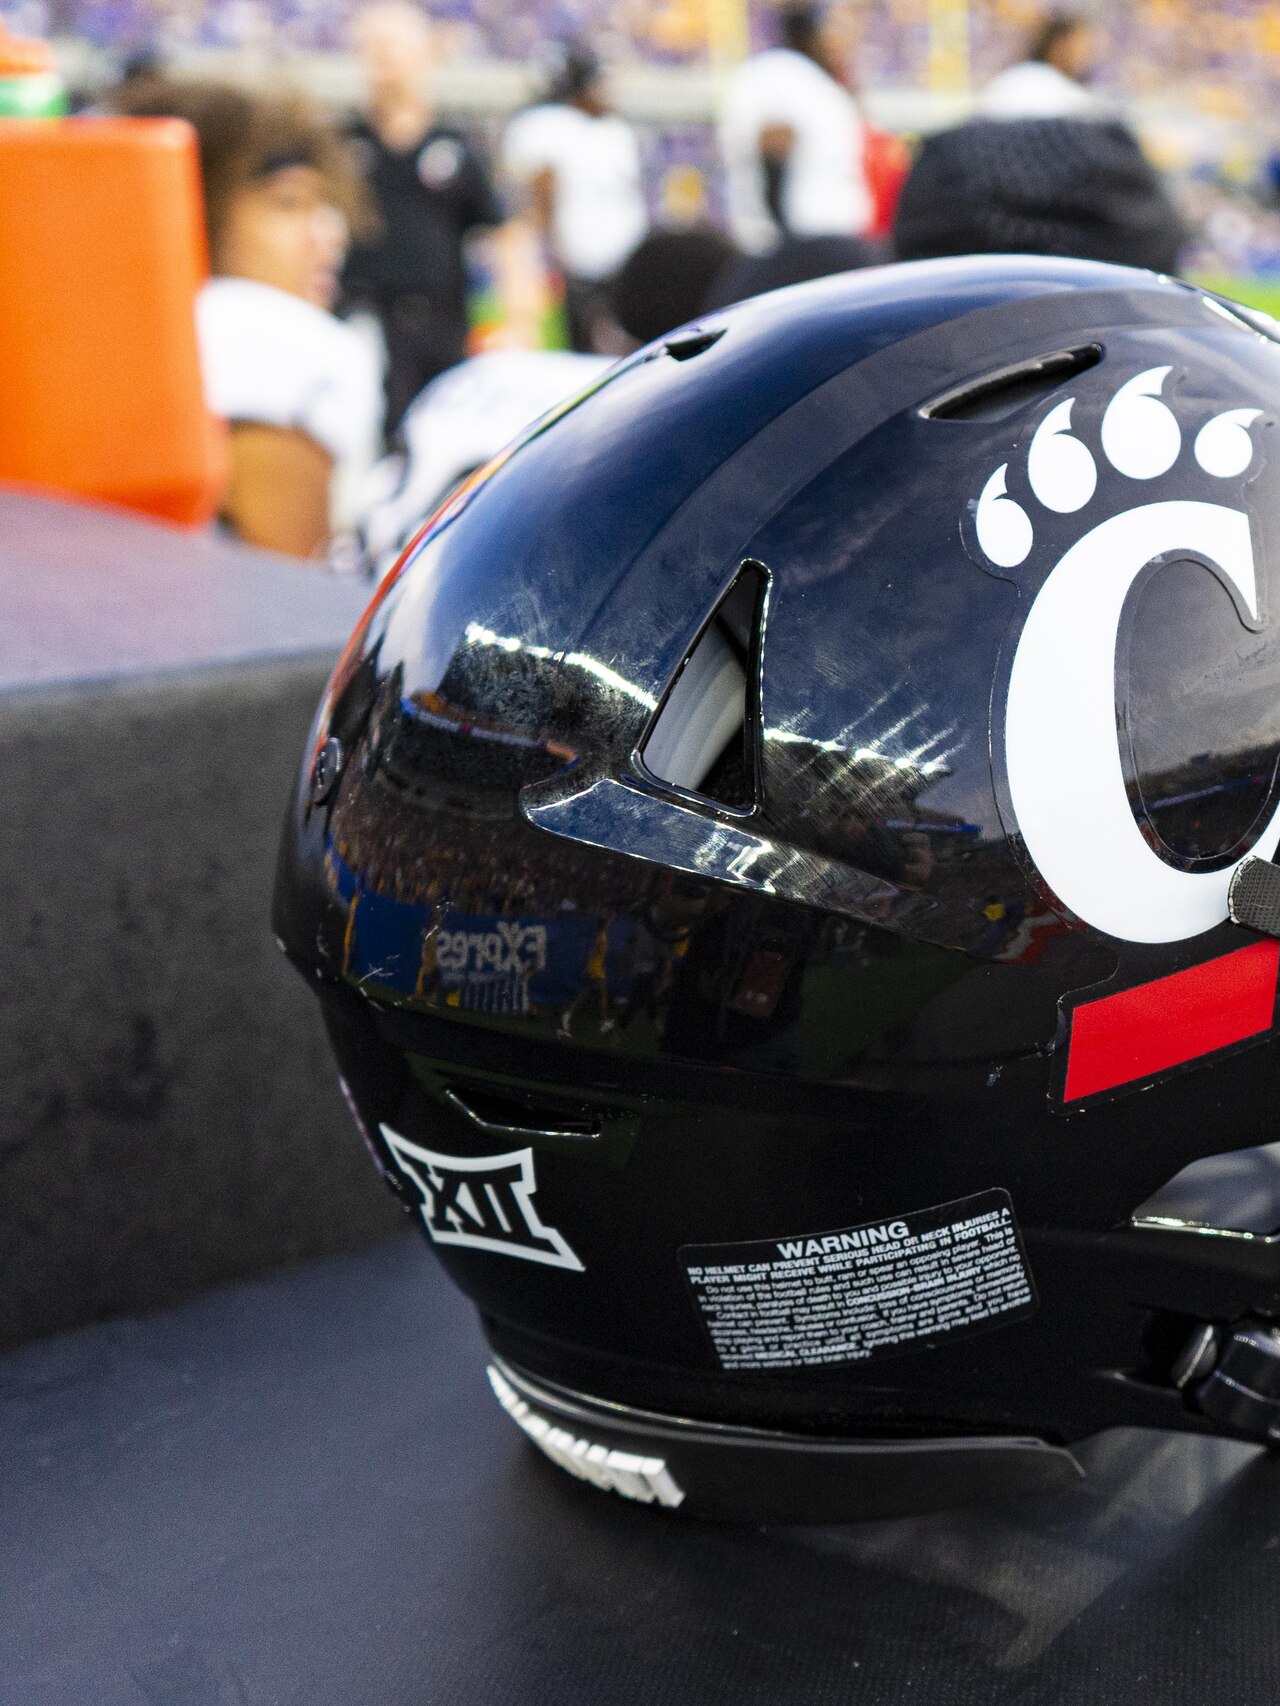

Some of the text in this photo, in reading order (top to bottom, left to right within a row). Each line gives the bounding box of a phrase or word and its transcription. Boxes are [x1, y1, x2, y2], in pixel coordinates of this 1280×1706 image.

[394, 1143, 572, 1263] XII
[687, 1207, 1010, 1276] NO HELMET CAN PREVENT SERIOUS HEAD OR NECK INJURIES A
[690, 1217, 1012, 1285] PLAYER MIGHT RECEIVE WHILE PARTICIPATING IN FOOTBALL.
[776, 1221, 909, 1259] WARNING
